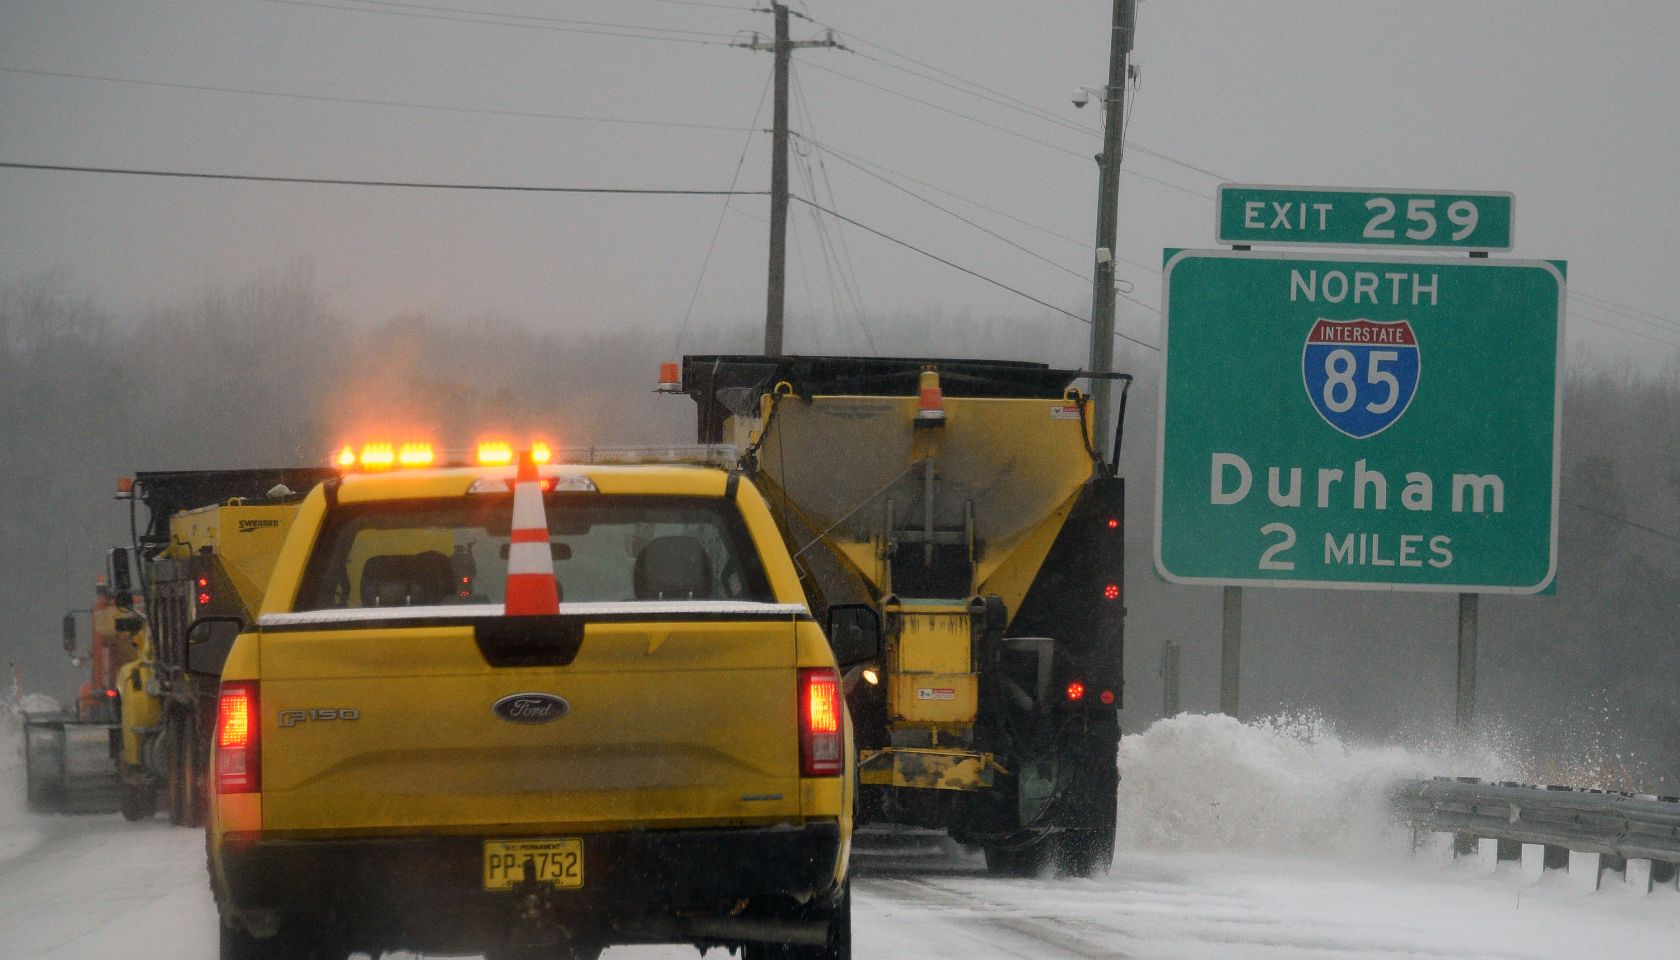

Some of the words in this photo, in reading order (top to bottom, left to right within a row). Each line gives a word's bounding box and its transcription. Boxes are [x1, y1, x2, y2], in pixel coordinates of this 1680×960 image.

[1243, 201, 1333, 231] EXIT
[1363, 197, 1479, 242] 259
[1289, 269, 1439, 306] NORTH
[1320, 325, 1404, 344] INTERSTATE
[1322, 348, 1400, 415] 85
[1210, 452, 1505, 513] Durham
[1258, 522, 1297, 571] 2
[1324, 532, 1454, 569] MILES
[510, 699, 552, 717] Ford
